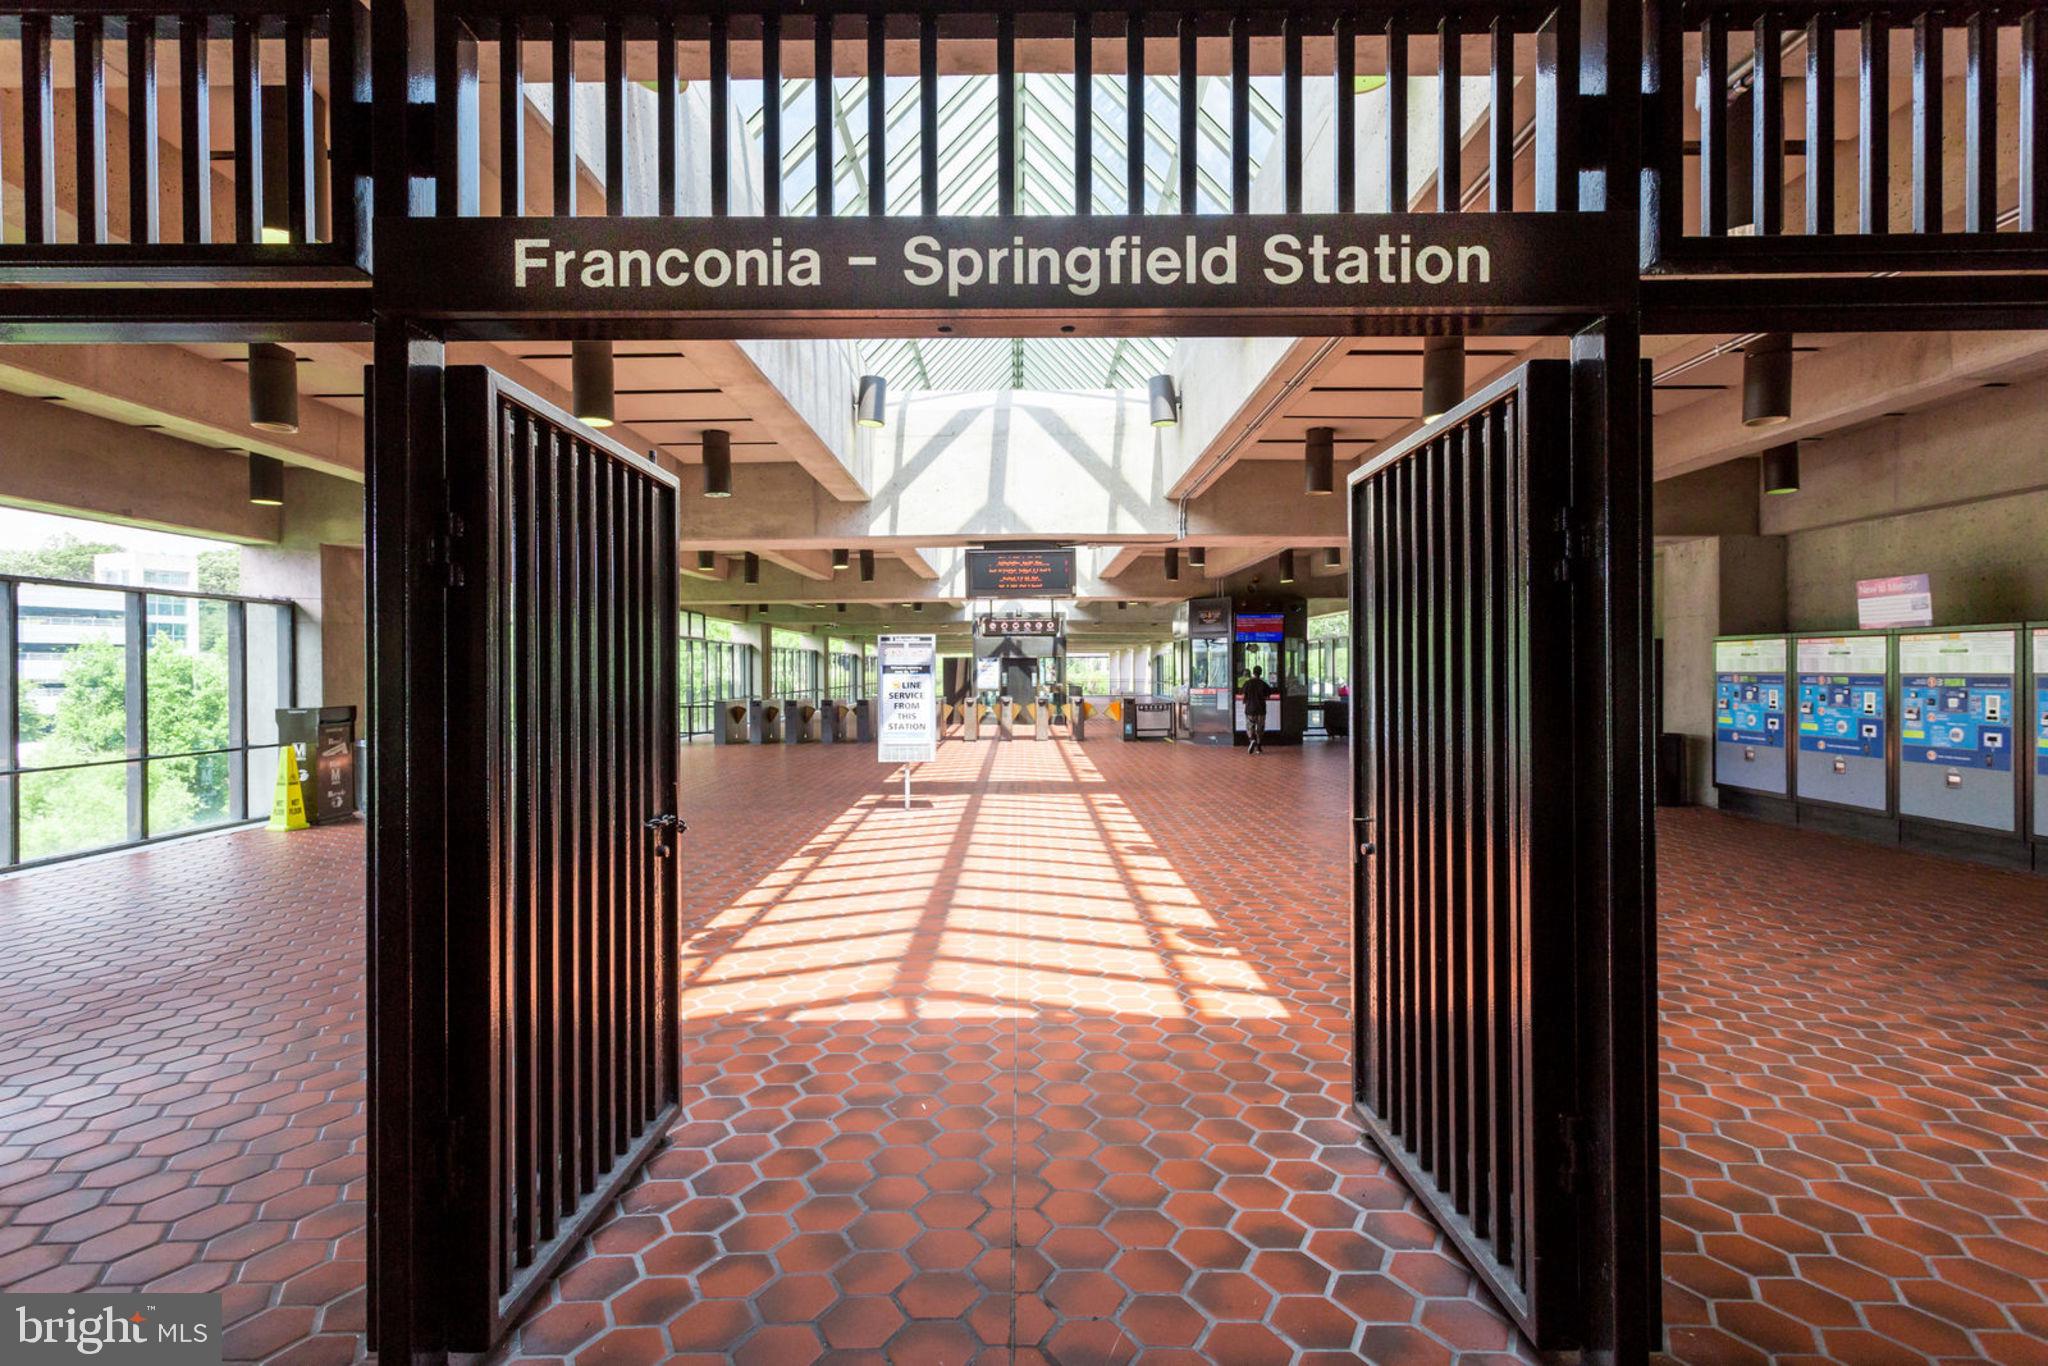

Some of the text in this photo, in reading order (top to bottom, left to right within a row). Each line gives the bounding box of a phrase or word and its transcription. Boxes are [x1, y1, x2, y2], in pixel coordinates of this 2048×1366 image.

[514, 237, 822, 288] Franconia
[903, 234, 1237, 297] Springfield
[1262, 233, 1491, 285] Station
[902, 681, 921, 689] LINE
[888, 692, 924, 700] SERVICE
[894, 702, 920, 710] FROM
[897, 712, 917, 720] THIS
[887, 722, 926, 731] STATION
